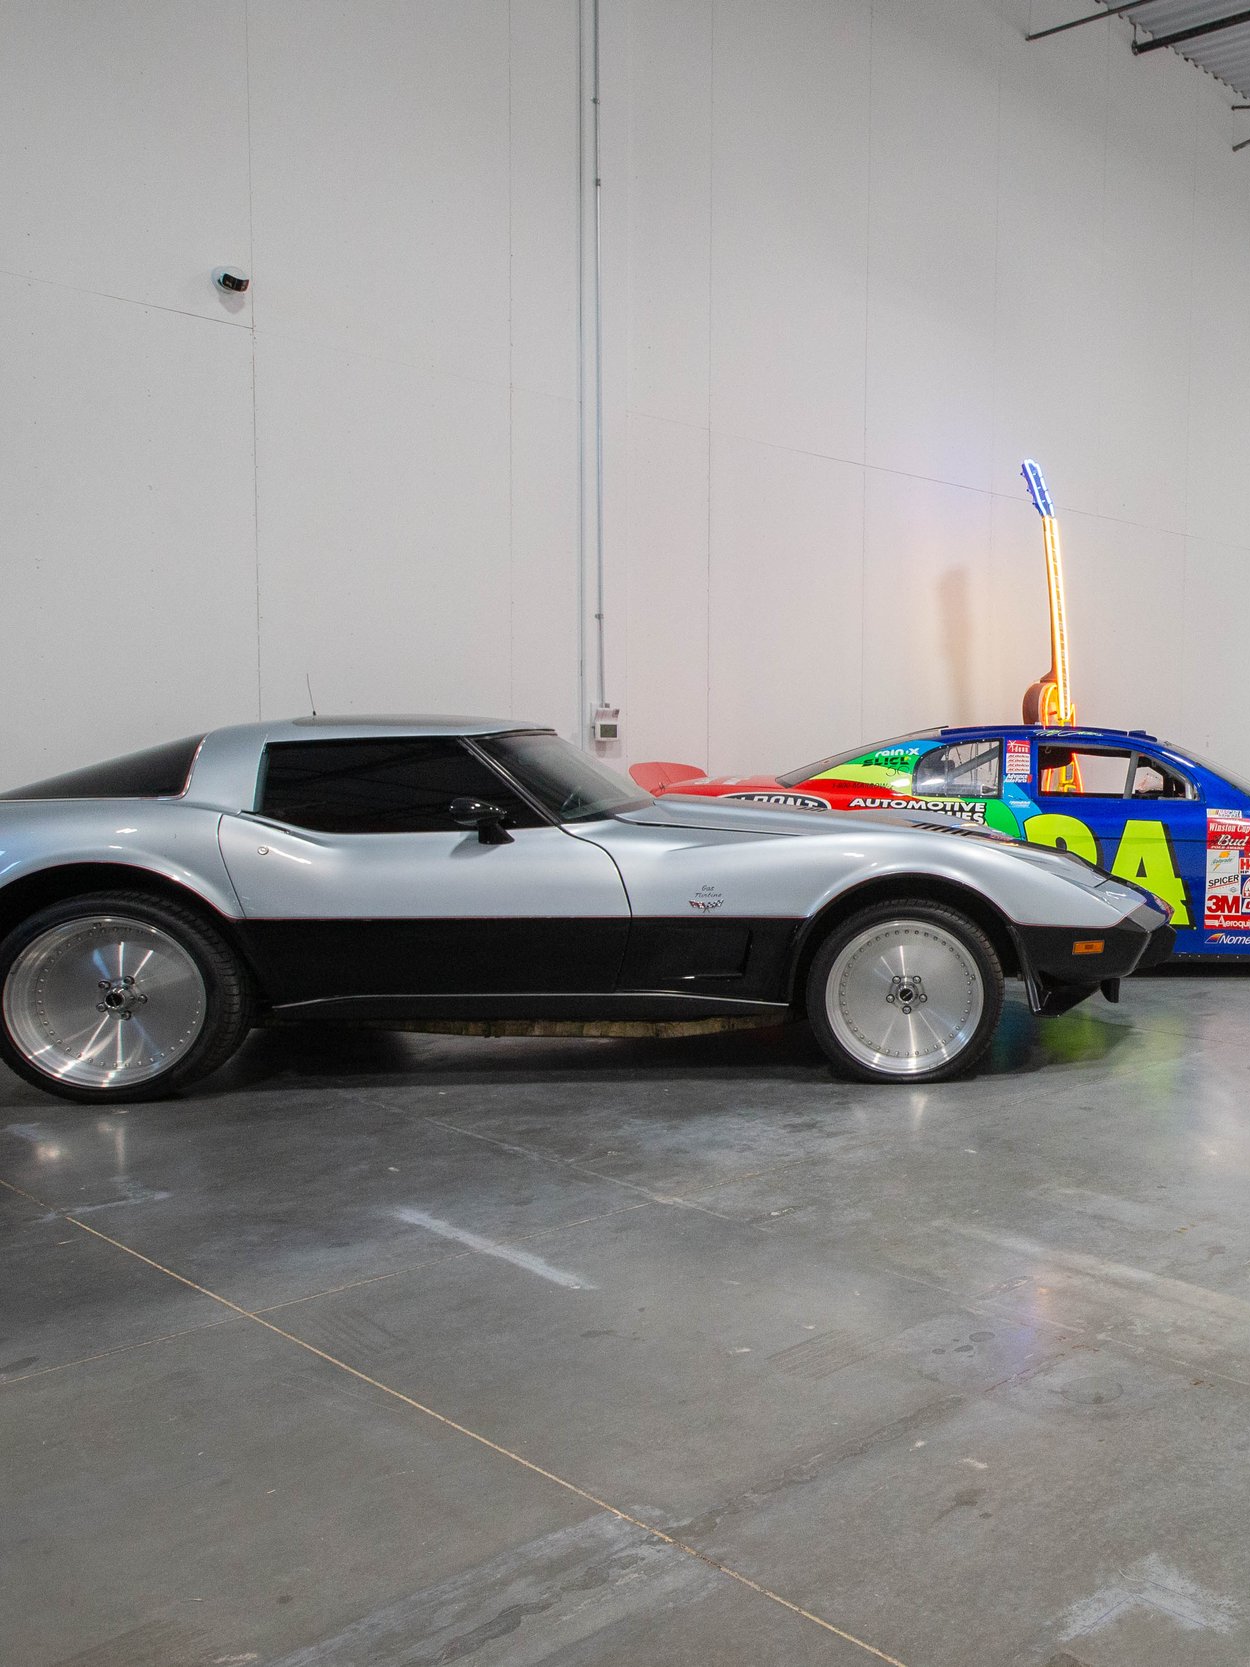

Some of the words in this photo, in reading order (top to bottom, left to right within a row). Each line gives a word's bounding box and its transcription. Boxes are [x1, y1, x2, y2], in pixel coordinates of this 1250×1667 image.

[849, 798, 986, 812] AUTOMOTIVE
[1209, 823, 1236, 833] Winston
[1237, 824, 1250, 834] Cup
[1217, 834, 1250, 846] Bud
[1208, 874, 1239, 887] SPICER
[1206, 895, 1240, 914] 3M
